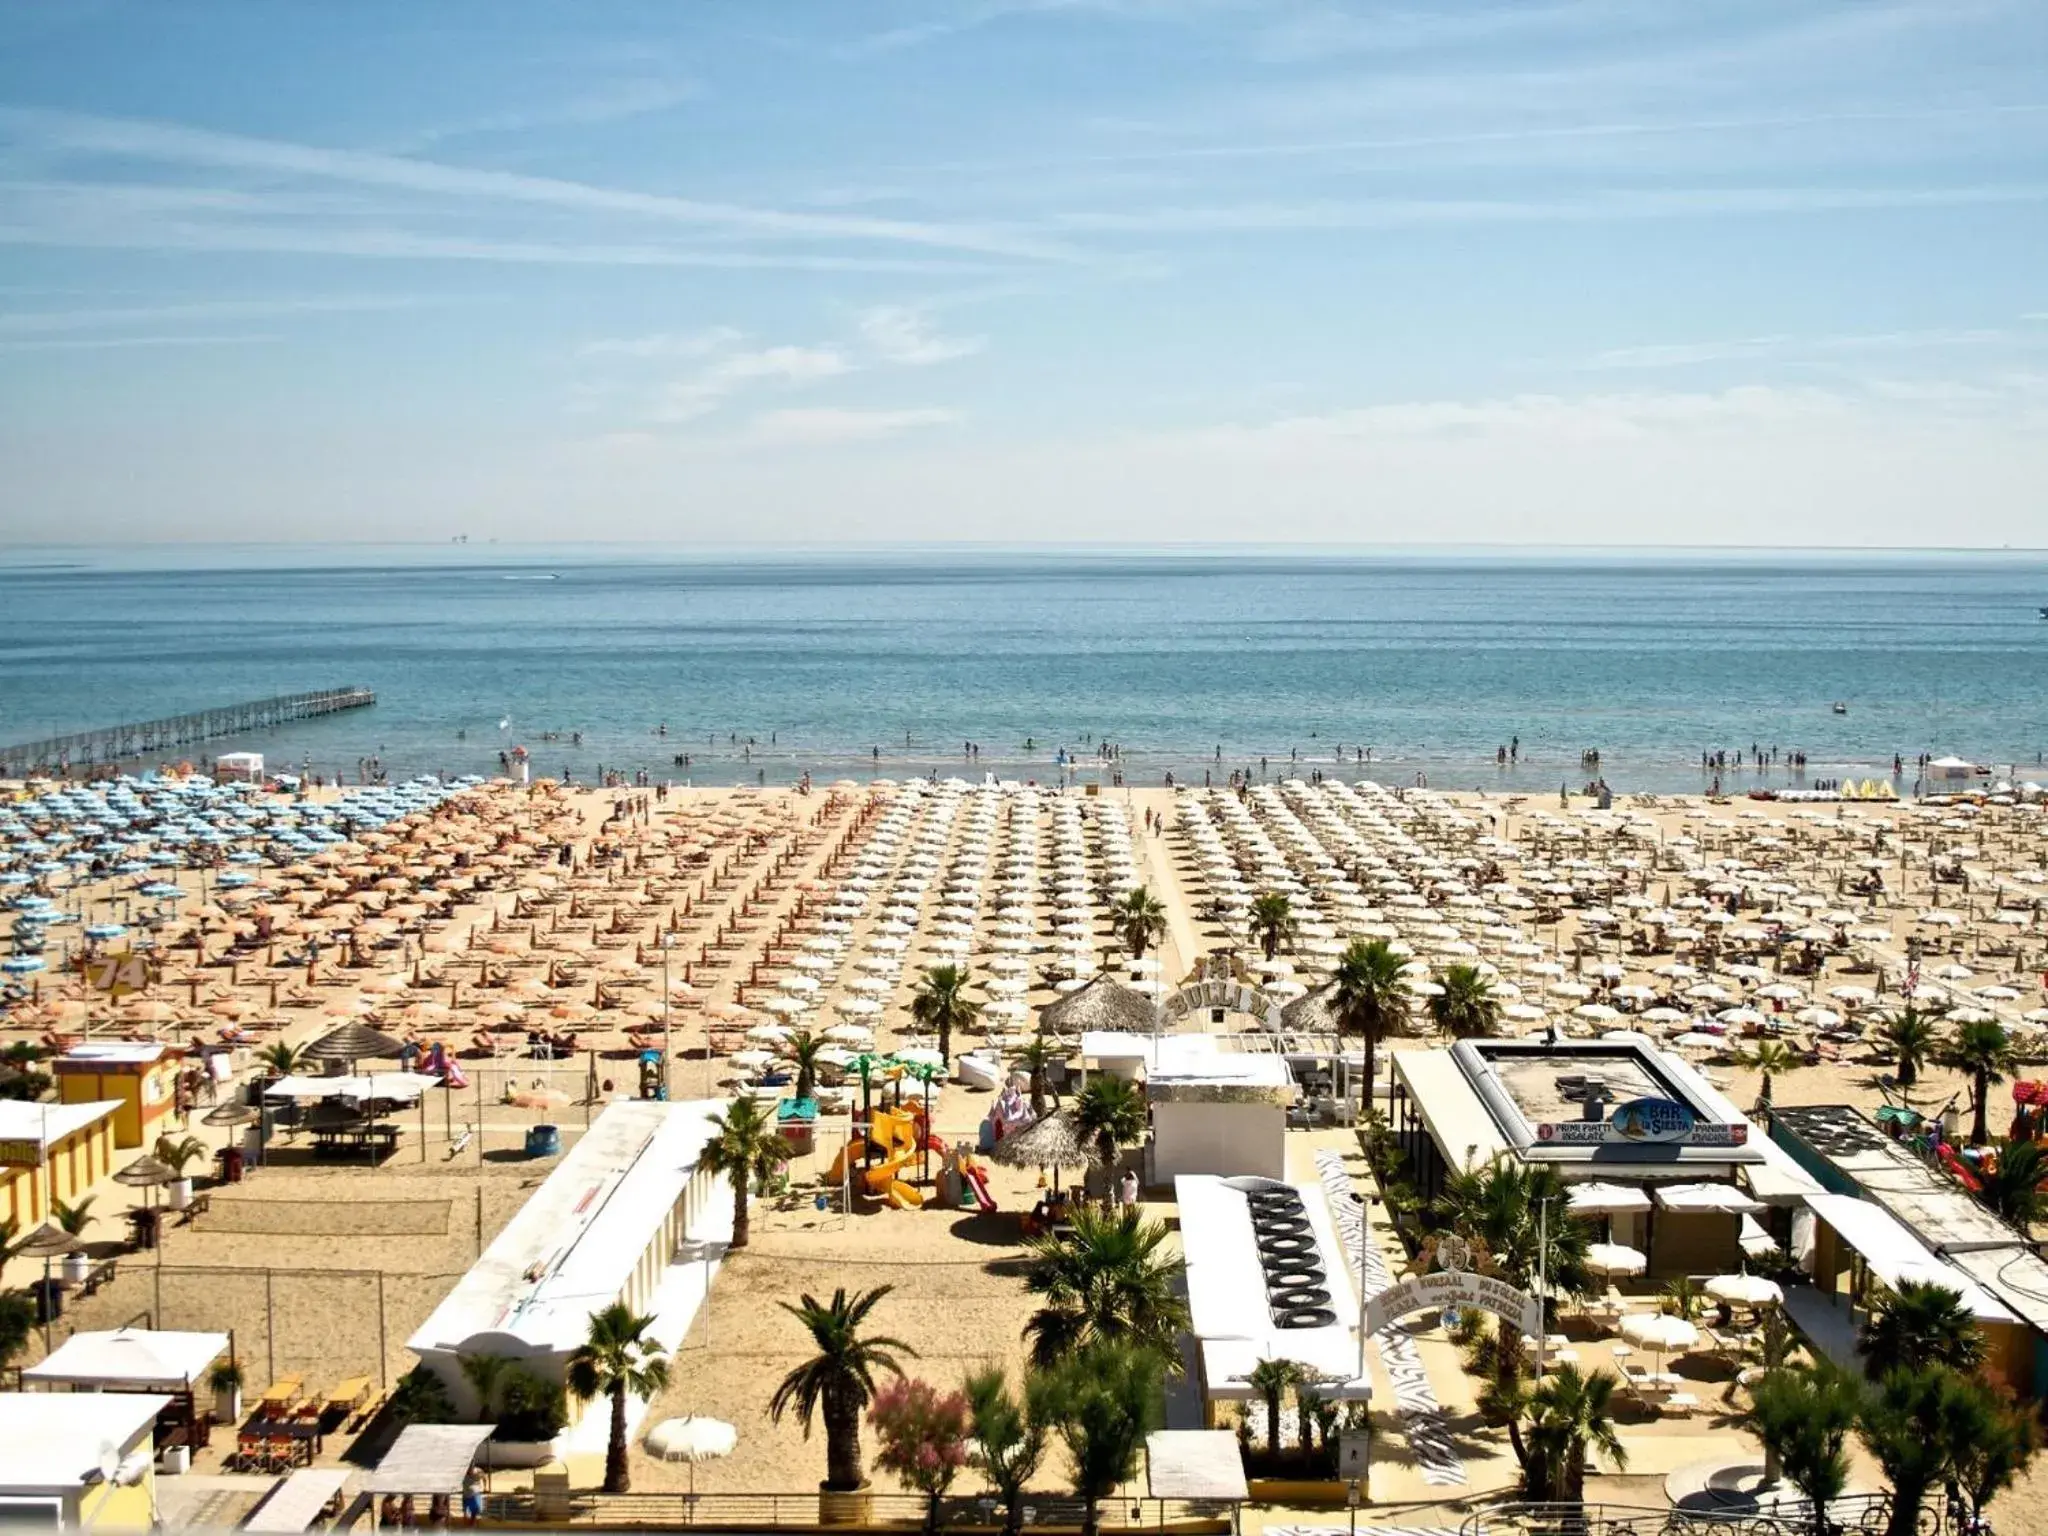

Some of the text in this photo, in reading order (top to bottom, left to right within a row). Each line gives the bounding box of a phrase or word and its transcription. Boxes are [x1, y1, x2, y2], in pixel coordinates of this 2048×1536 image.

[91, 957, 147, 991] 74
[1650, 1105, 1682, 1120] BAR
[1555, 1123, 1612, 1132] PRIMI PIATTI
[1694, 1125, 1728, 1133] PANINI
